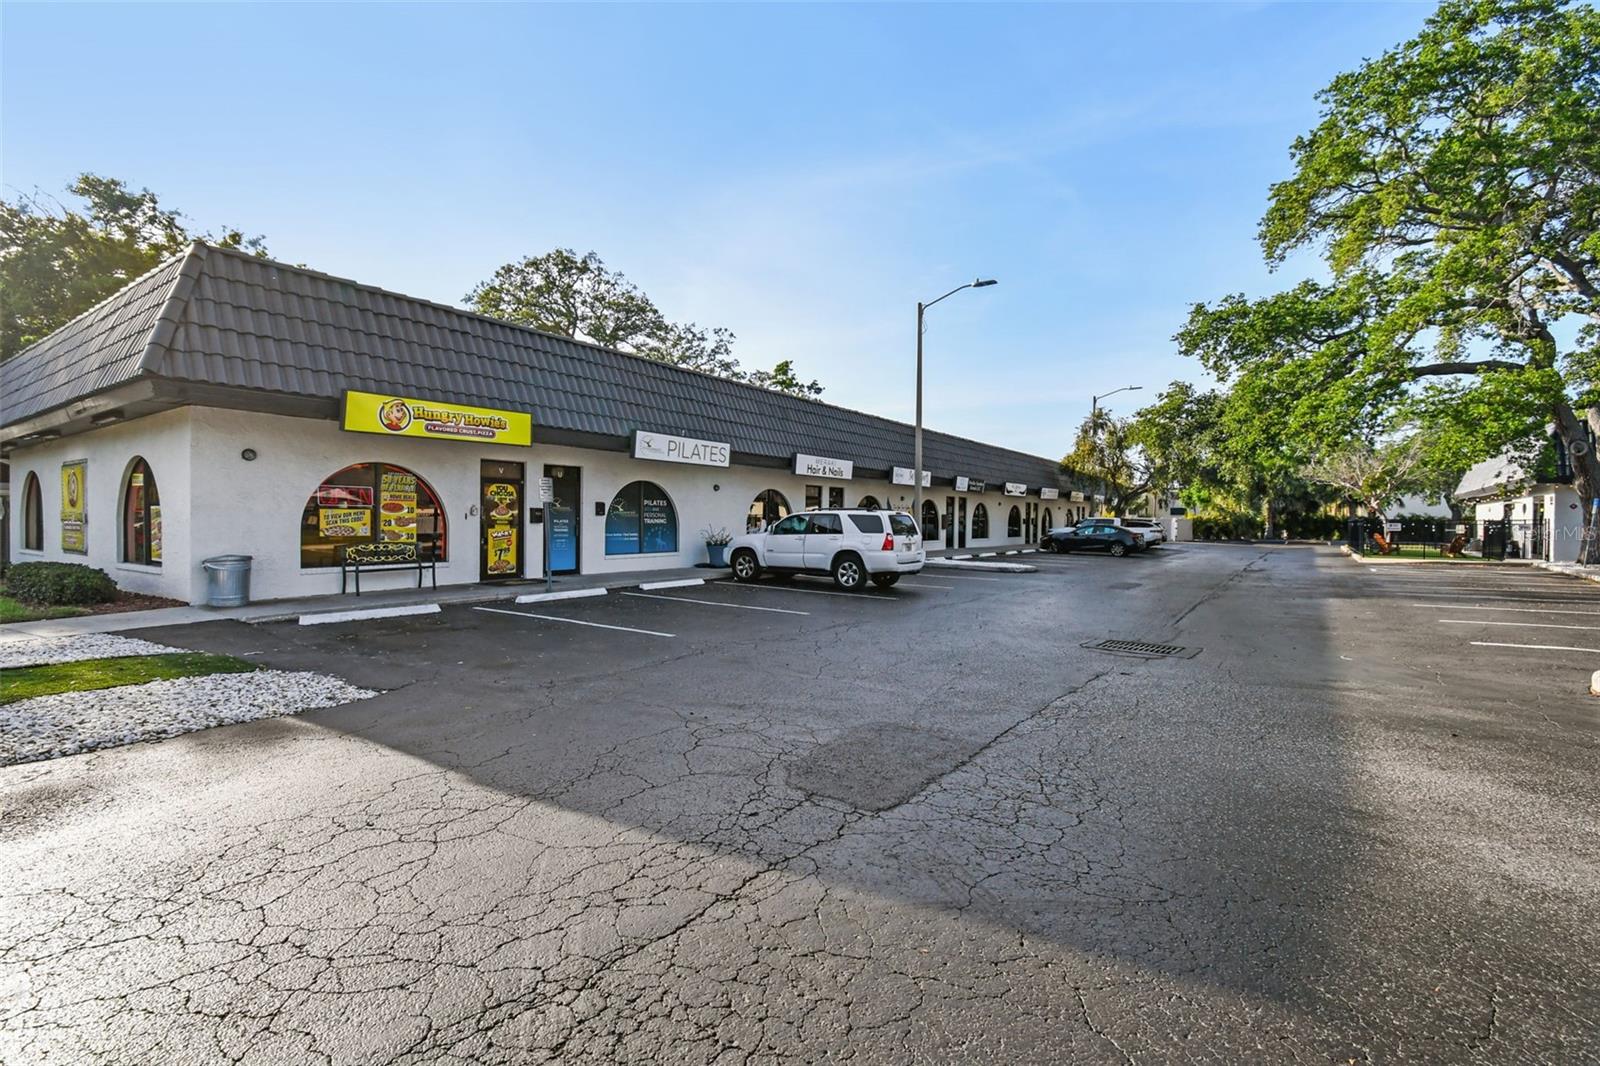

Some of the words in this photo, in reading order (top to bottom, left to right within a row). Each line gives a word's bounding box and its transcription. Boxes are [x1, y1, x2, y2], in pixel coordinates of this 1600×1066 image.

[412, 406, 463, 424] Hungry
[464, 413, 507, 430] Howie's
[427, 425, 458, 433] FLAVORED
[667, 440, 727, 463] PILATES
[807, 464, 821, 475] Hair
[822, 466, 827, 475] &
[828, 467, 844, 477] Nails
[643, 499, 667, 507] PILATES
